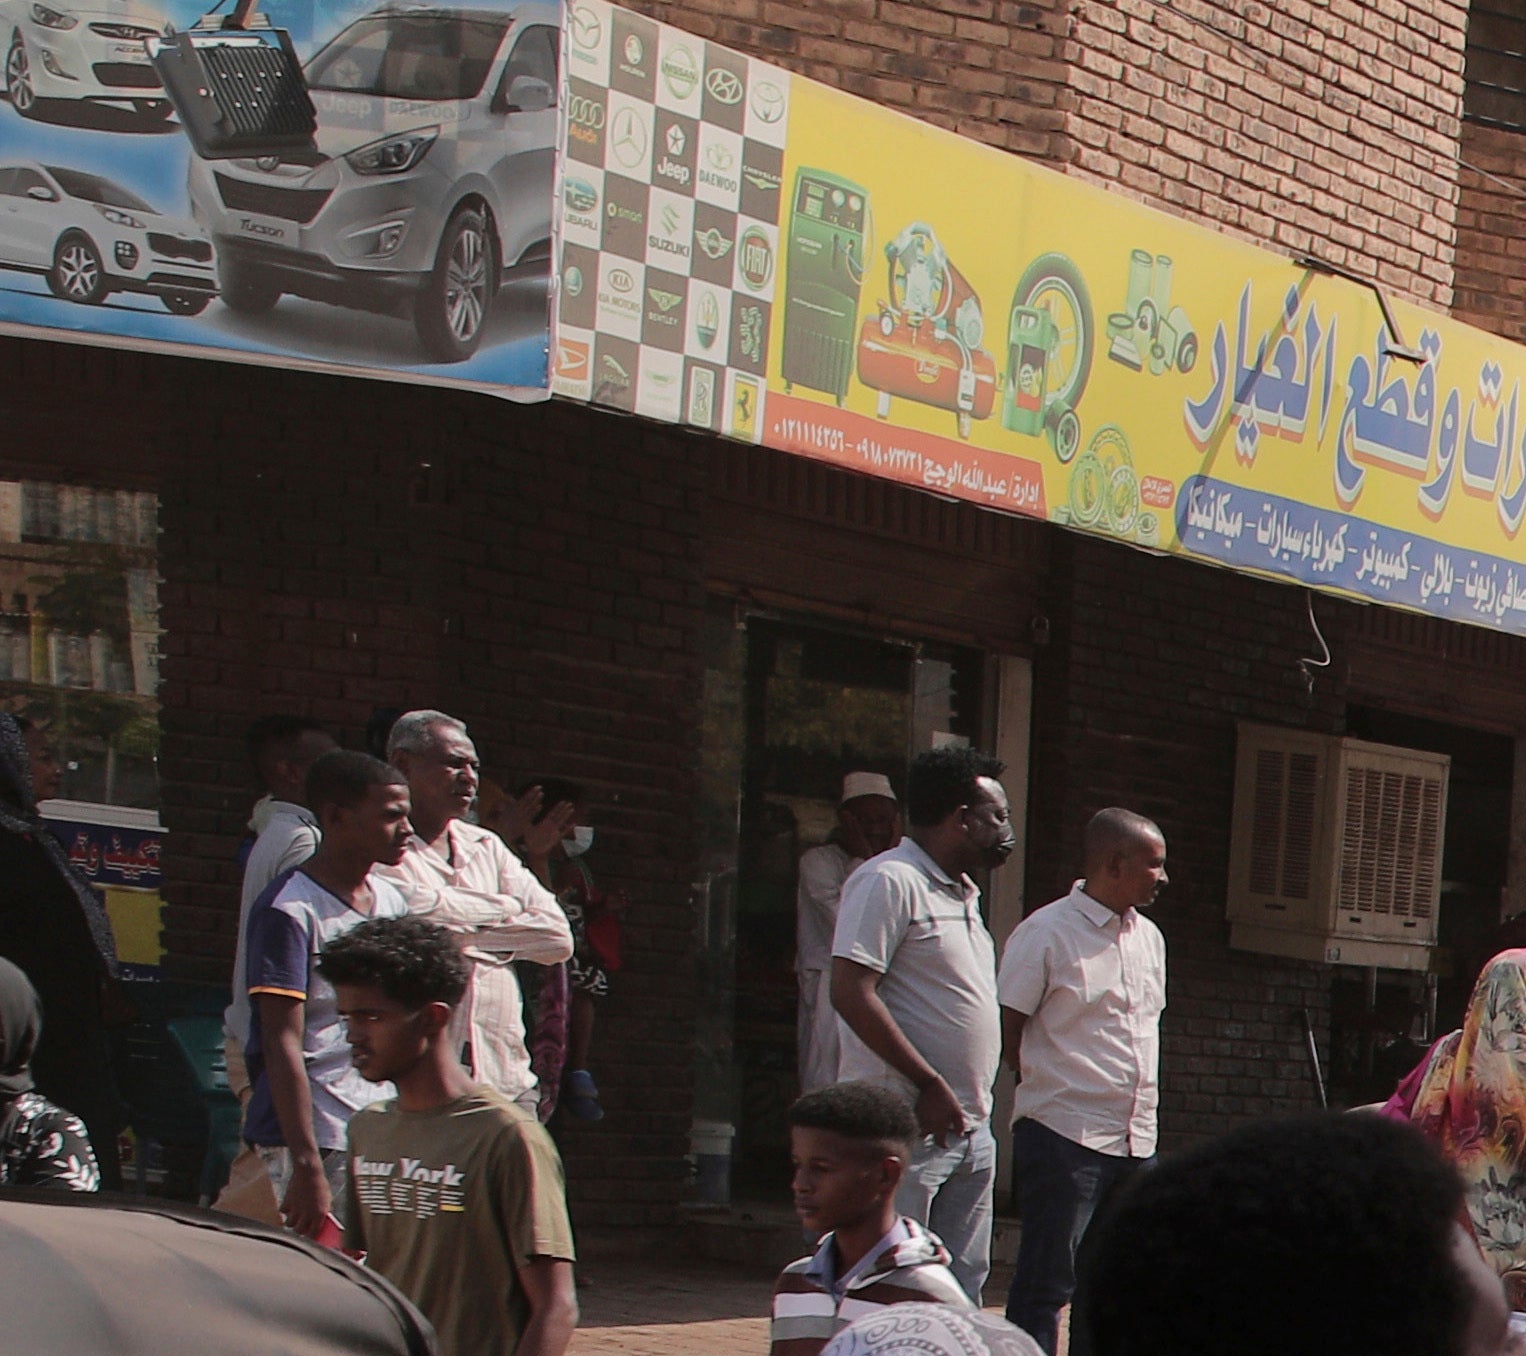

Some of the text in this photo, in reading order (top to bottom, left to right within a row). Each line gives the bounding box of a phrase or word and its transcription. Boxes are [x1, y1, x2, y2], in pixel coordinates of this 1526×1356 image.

[657, 156, 690, 185] Jeep
[699, 169, 738, 194] DAEWOO
[239, 217, 286, 238] Tucson
[648, 235, 690, 258] SUZUKI
[746, 243, 769, 276] FIAT
[1183, 277, 1339, 468] الغيار
[1333, 322, 1461, 523] وقطع
[1187, 484, 1244, 549] ميكانيكا
[400, 1157, 465, 1187] York
